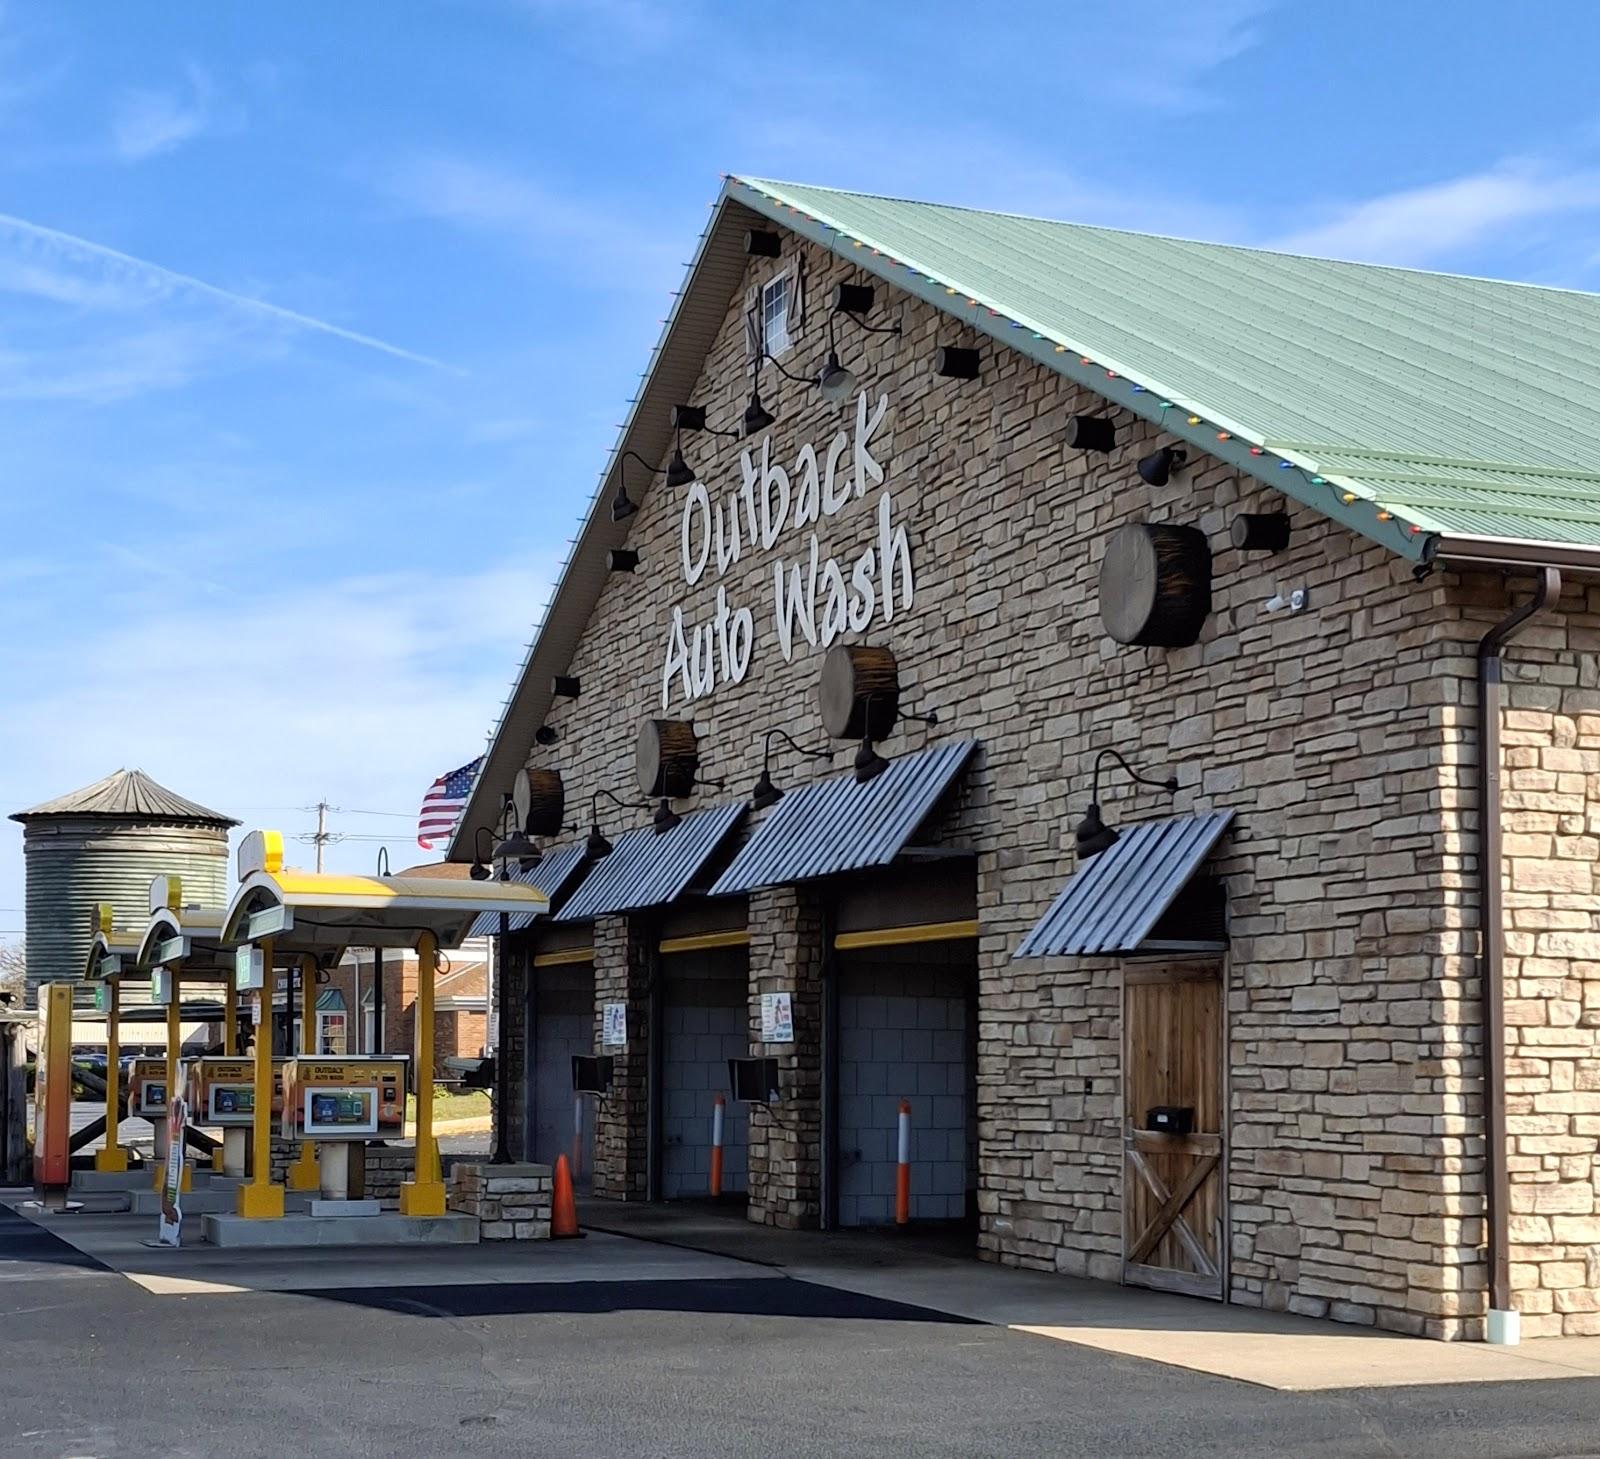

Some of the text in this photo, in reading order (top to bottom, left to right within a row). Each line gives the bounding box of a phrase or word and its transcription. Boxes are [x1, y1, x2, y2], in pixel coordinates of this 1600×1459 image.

[682, 390, 889, 585] Outback
[662, 491, 914, 710] Auto Wash
